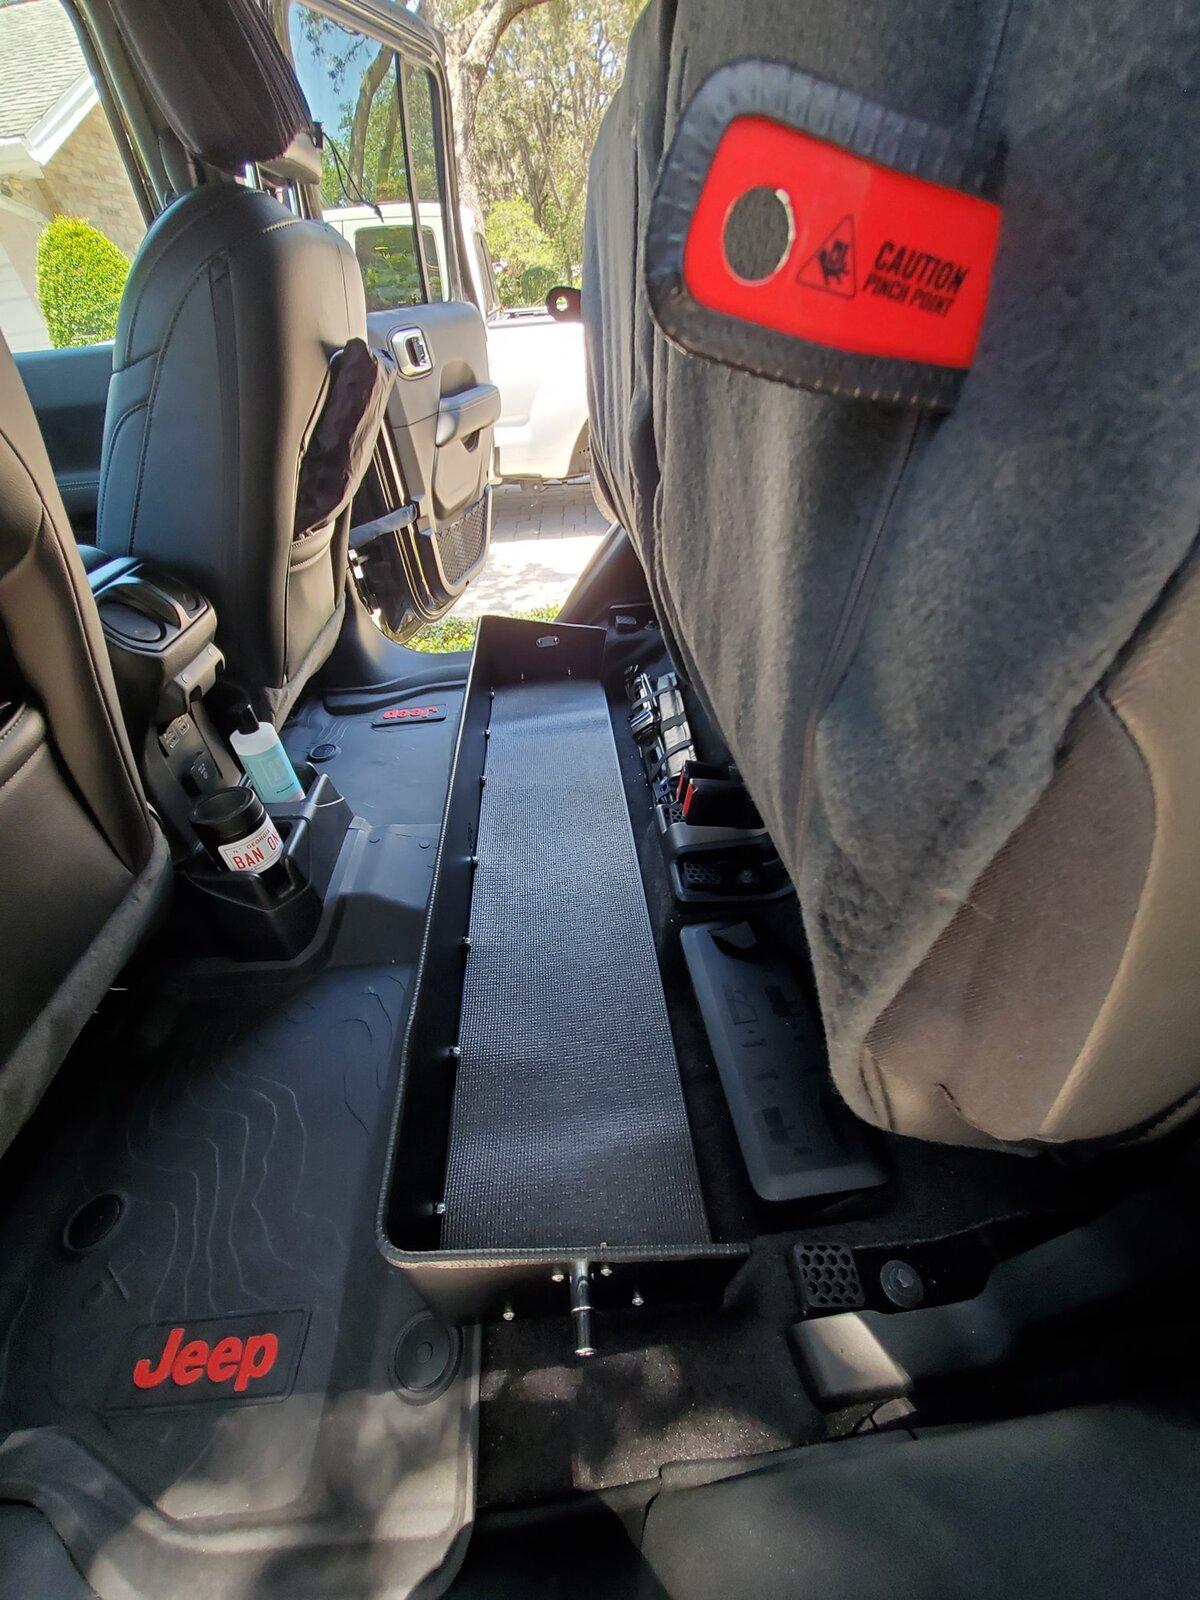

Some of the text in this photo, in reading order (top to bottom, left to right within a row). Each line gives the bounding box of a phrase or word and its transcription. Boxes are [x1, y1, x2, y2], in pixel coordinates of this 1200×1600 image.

[874, 240, 969, 294] CAUTION
[862, 273, 955, 317] PINCH POINT
[232, 847, 264, 869] BAN
[133, 1327, 278, 1392] Jeep
